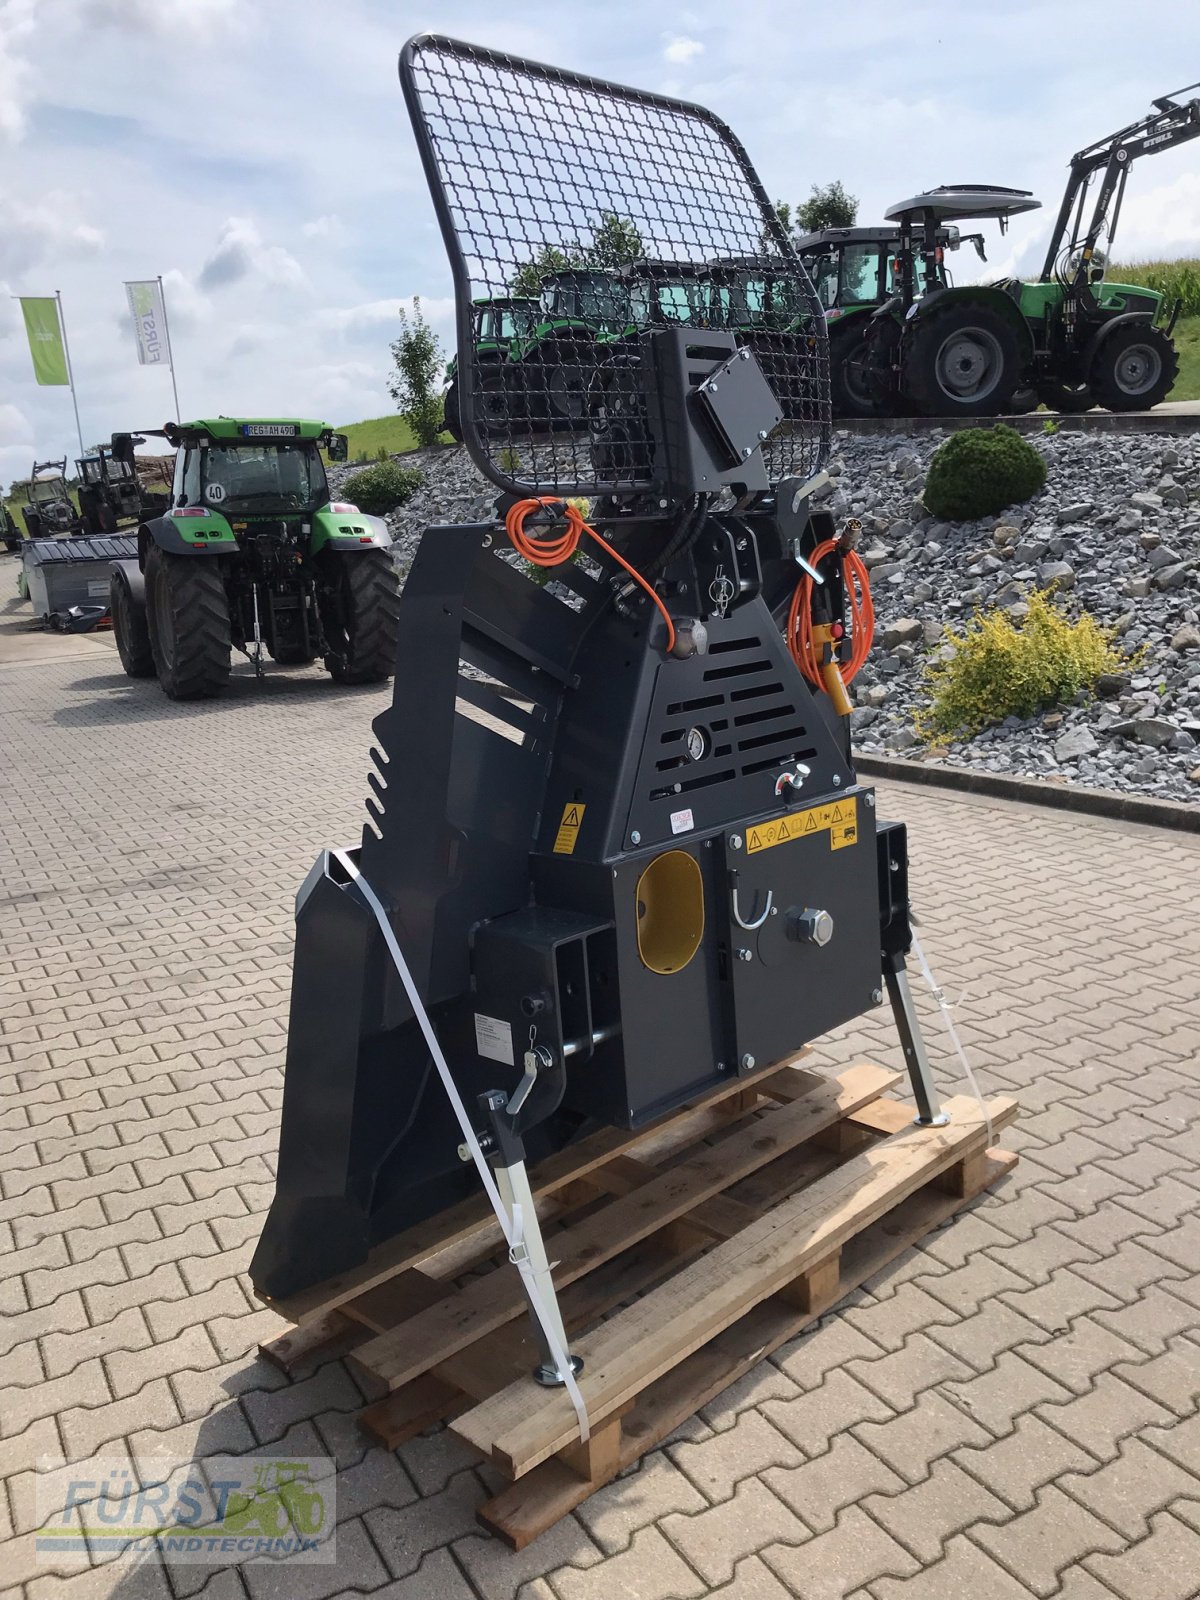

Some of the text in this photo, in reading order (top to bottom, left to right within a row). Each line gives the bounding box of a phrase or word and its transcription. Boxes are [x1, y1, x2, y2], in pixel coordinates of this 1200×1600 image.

[248, 426, 294, 434] REG AH 490
[209, 486, 222, 500] 40
